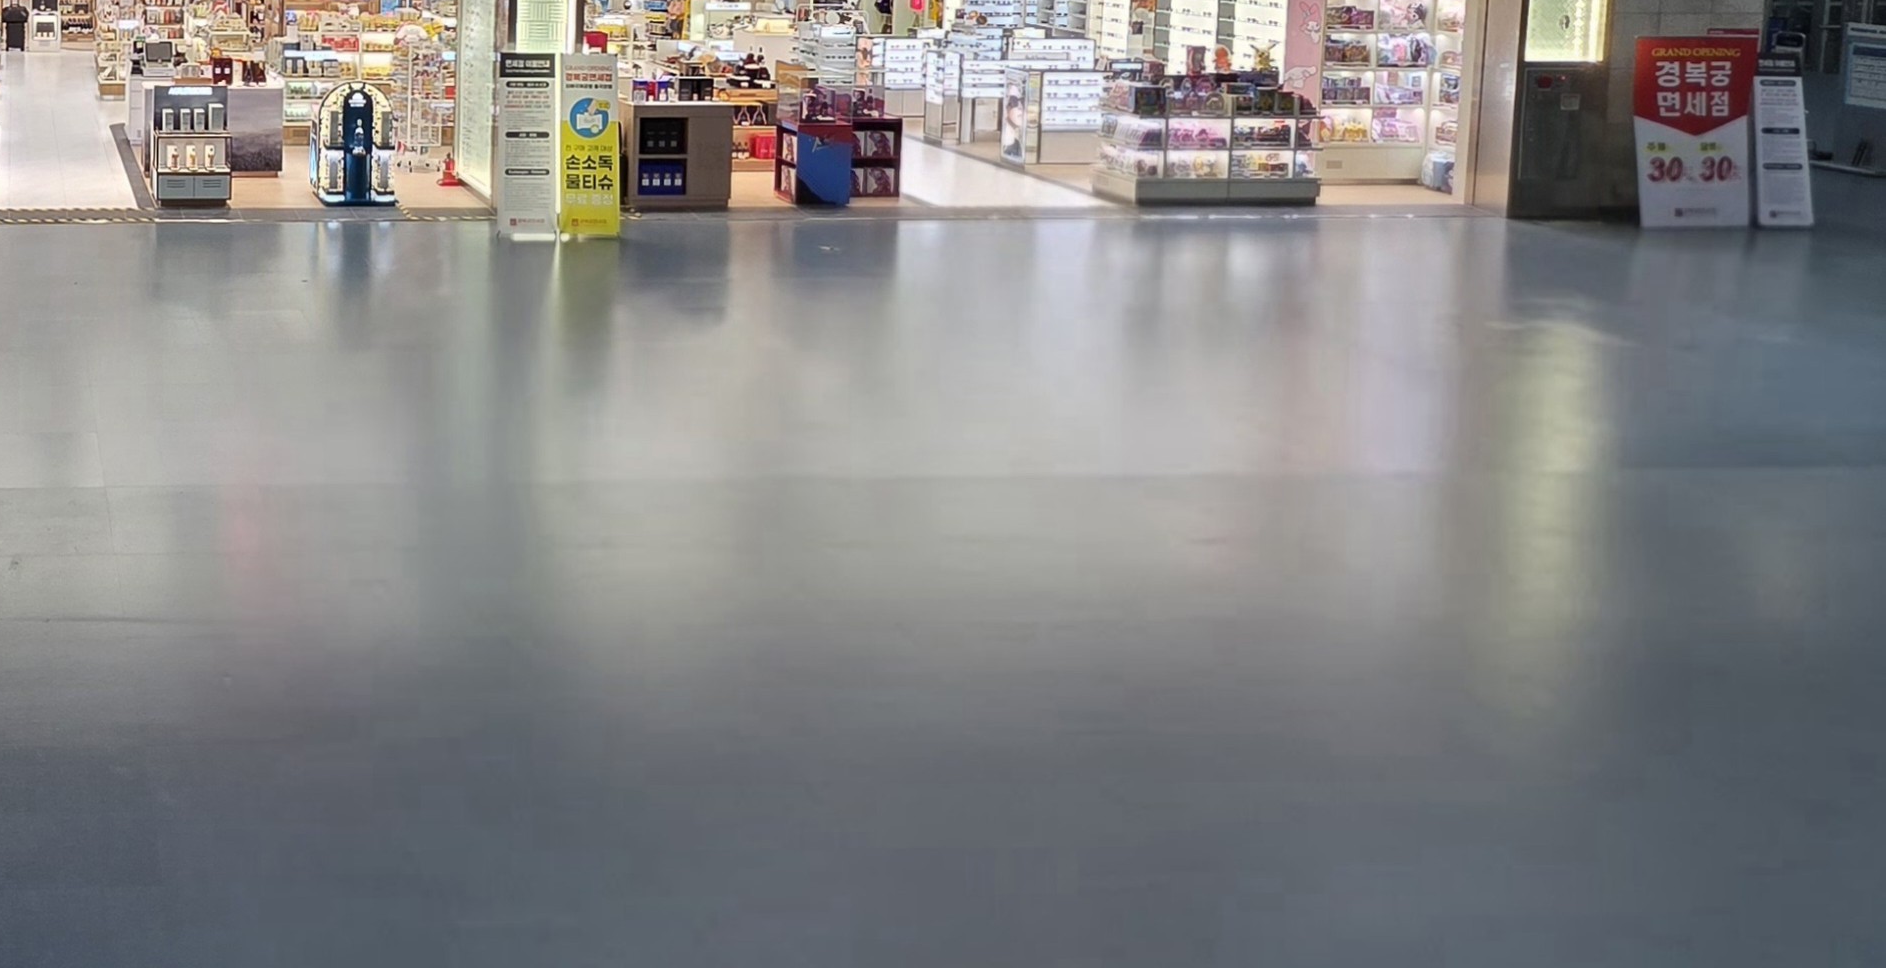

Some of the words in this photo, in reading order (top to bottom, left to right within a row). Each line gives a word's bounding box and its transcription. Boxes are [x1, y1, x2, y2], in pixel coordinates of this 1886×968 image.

[1652, 48, 1692, 57] GRAND
[1693, 48, 1741, 57] OPENING
[1655, 61, 1732, 87] 경복궁
[1656, 91, 1730, 117] 면세점
[565, 154, 613, 171] 손소독
[1647, 156, 1683, 182] 30
[1699, 156, 1733, 182] 30
[565, 174, 613, 190] 물티슈
